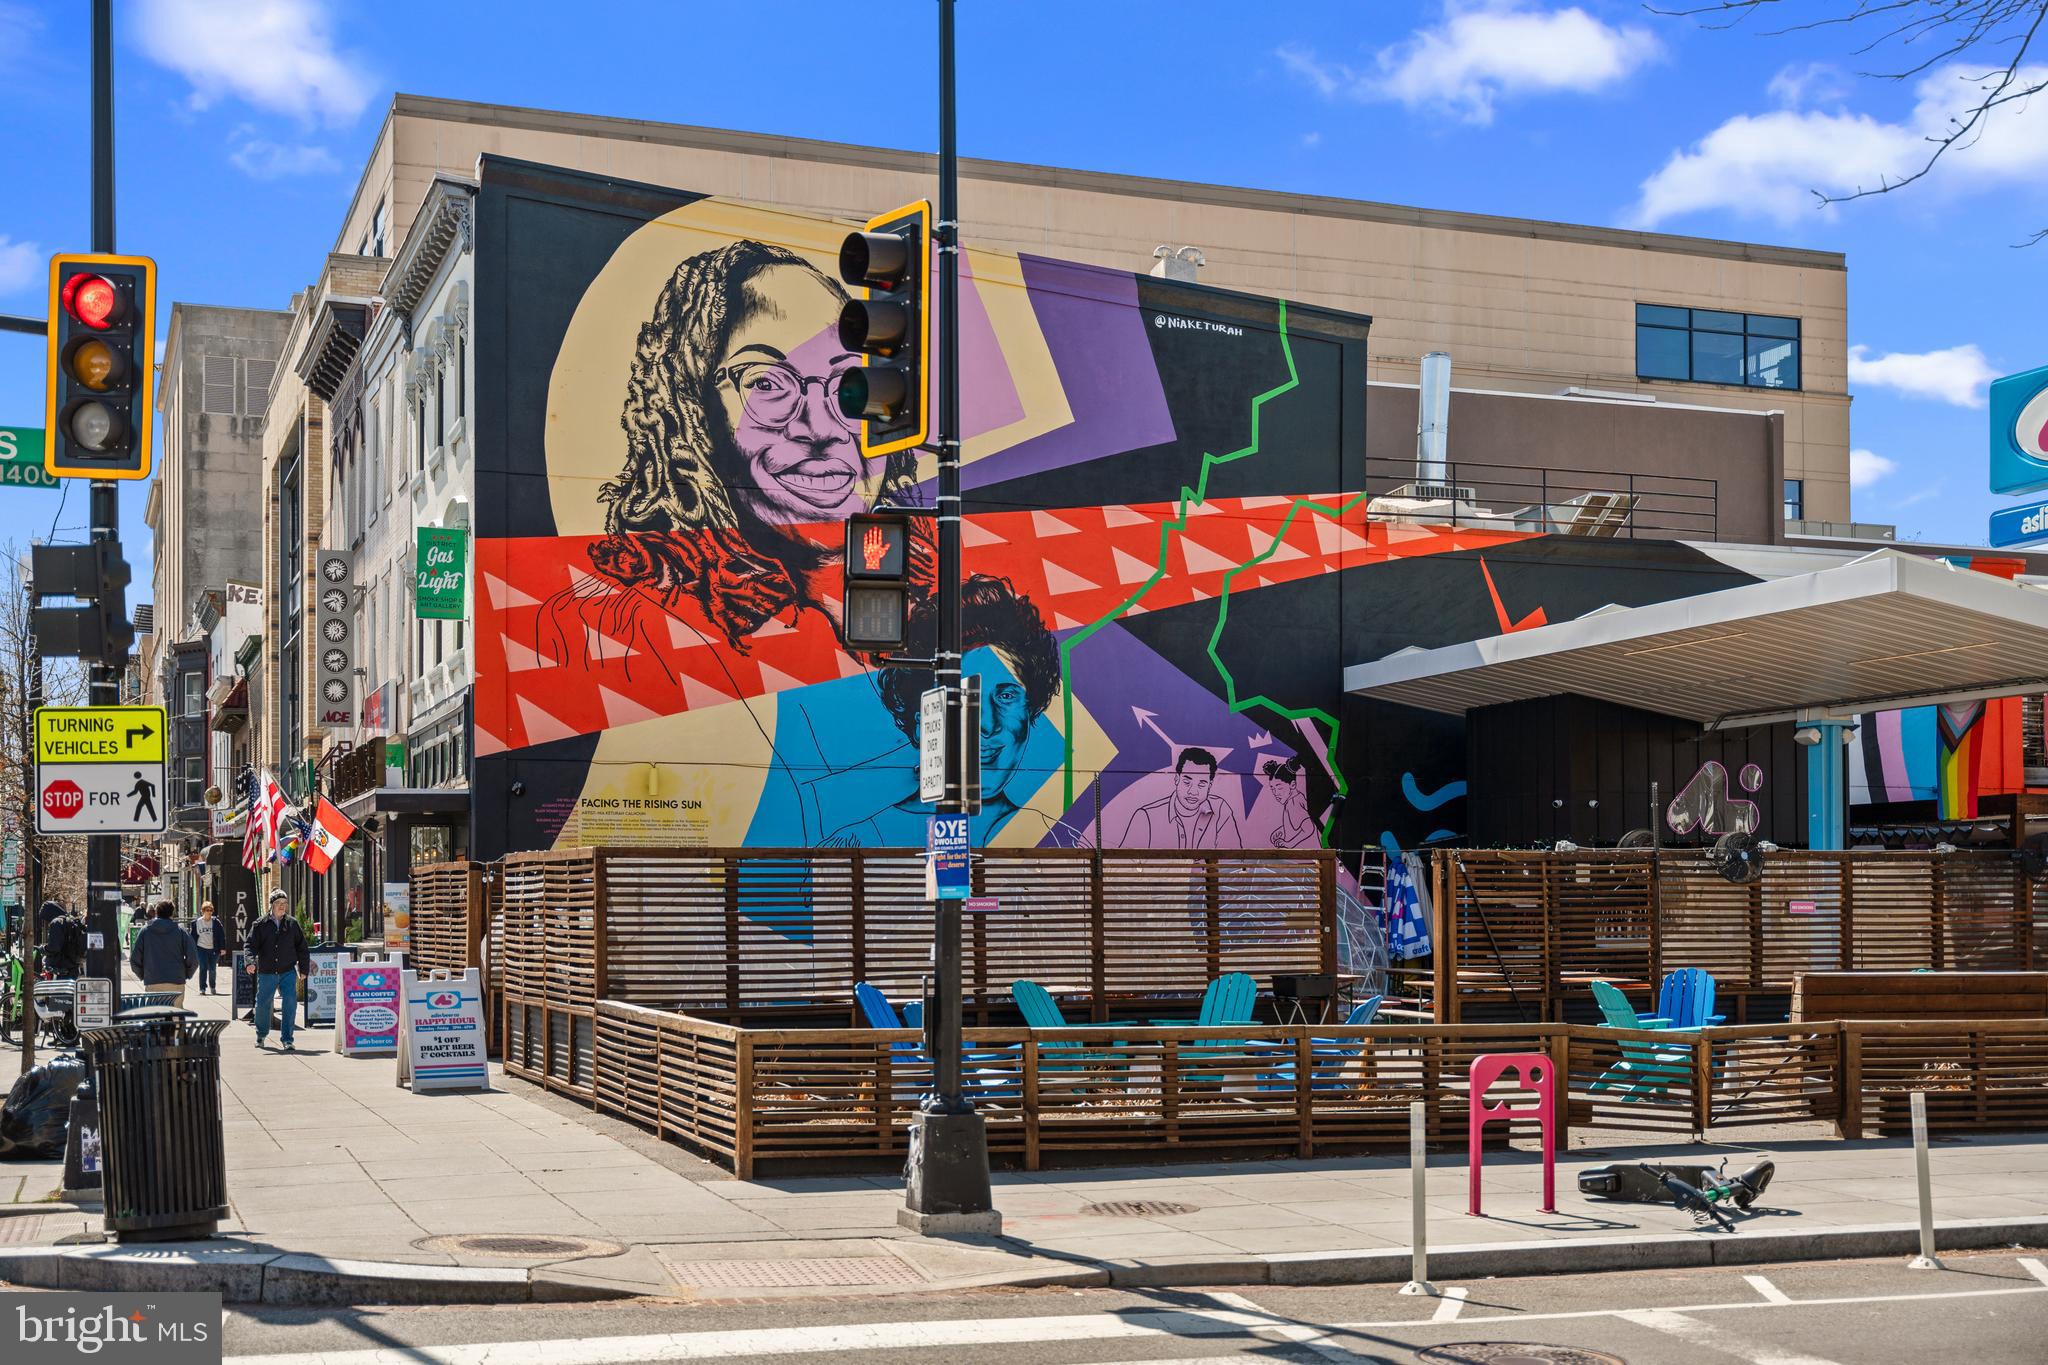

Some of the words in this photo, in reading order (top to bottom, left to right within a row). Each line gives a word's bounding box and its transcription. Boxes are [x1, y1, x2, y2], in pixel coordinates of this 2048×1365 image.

[0, 463, 57, 486] 1400
[426, 546, 455, 567] Gas
[418, 571, 464, 595] Light
[320, 710, 350, 723] ACE
[48, 718, 115, 732] TURNING
[45, 741, 118, 755] VEHICLES
[45, 792, 82, 807] STOP
[89, 792, 120, 806] FOR
[581, 798, 620, 809] FACING
[622, 799, 642, 809] THE
[644, 799, 679, 809] RISING
[681, 800, 703, 809] SUN
[934, 820, 967, 838] OYE
[934, 837, 967, 845] OWOLEWA
[235, 891, 247, 942] PAWN
[320, 969, 337, 977] FRE
[313, 977, 337, 985] CHICK
[415, 1018, 447, 1026] HAPPY
[449, 1017, 476, 1025] HOUR
[433, 1036, 442, 1044] $1
[420, 1044, 450, 1052] DRAFT
[452, 1043, 475, 1051] BEER
[429, 1050, 476, 1058] COCKTAILS
